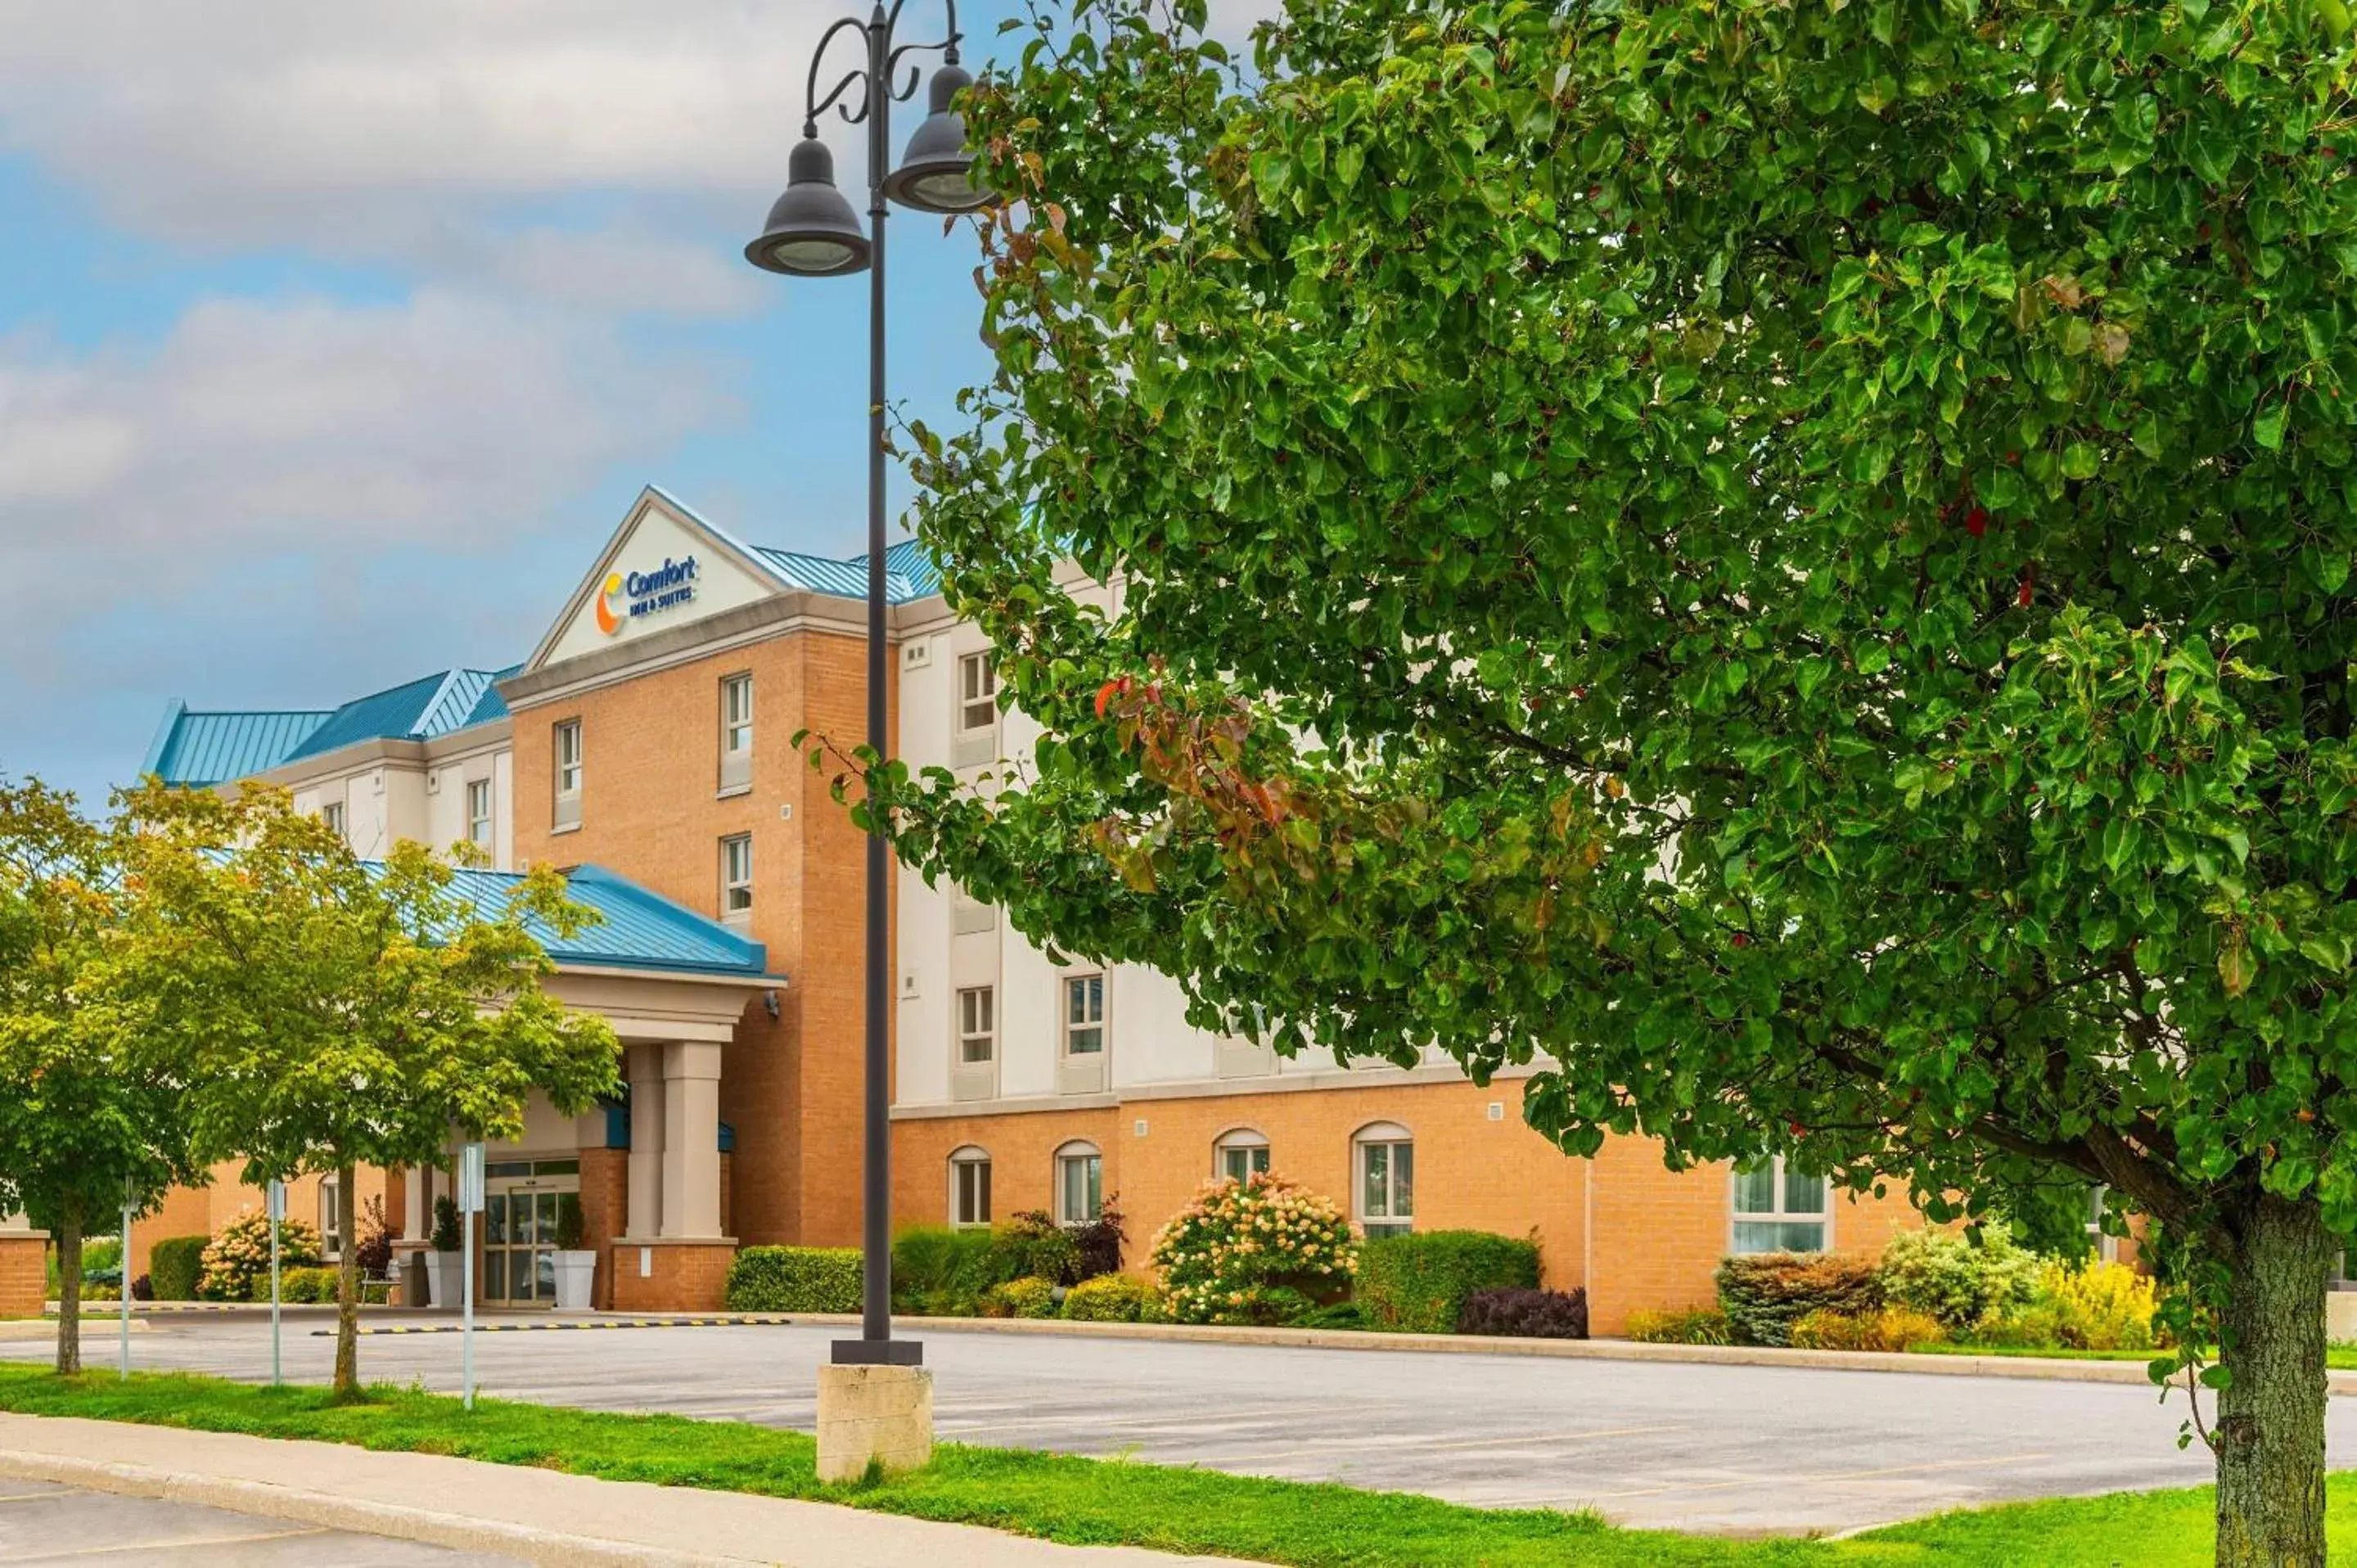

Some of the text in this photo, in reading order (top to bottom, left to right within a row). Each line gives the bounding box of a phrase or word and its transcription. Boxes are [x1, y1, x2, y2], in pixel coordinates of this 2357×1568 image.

[627, 555, 695, 597] Comfort
[630, 586, 692, 616] INN & SUITES
